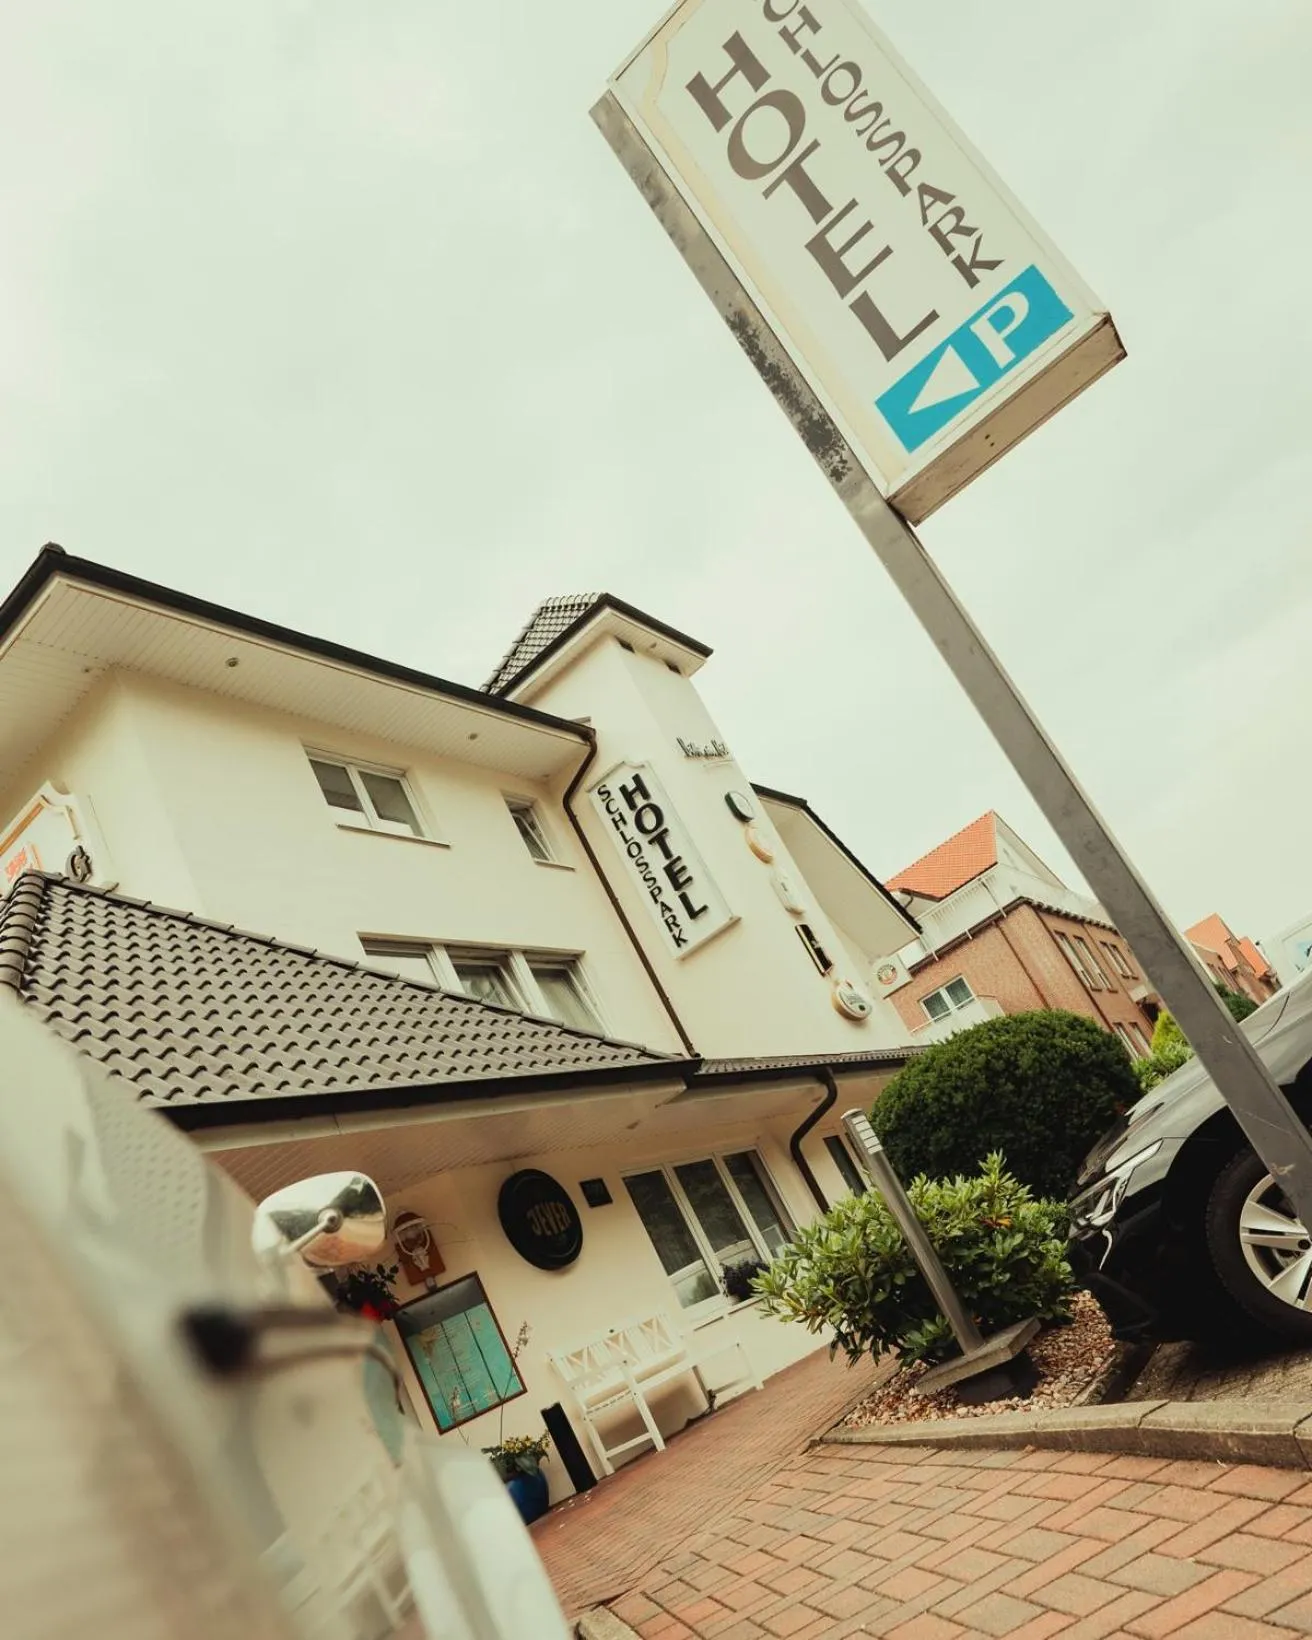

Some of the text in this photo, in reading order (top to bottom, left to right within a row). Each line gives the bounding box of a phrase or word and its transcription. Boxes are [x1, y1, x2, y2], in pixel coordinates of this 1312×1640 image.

[685, 30, 940, 363] HOTEL
[969, 291, 1030, 370] P
[596, 783, 689, 948] SCHLOSSPARK
[618, 773, 709, 920] HOTEL
[527, 1202, 572, 1236] JEVER
